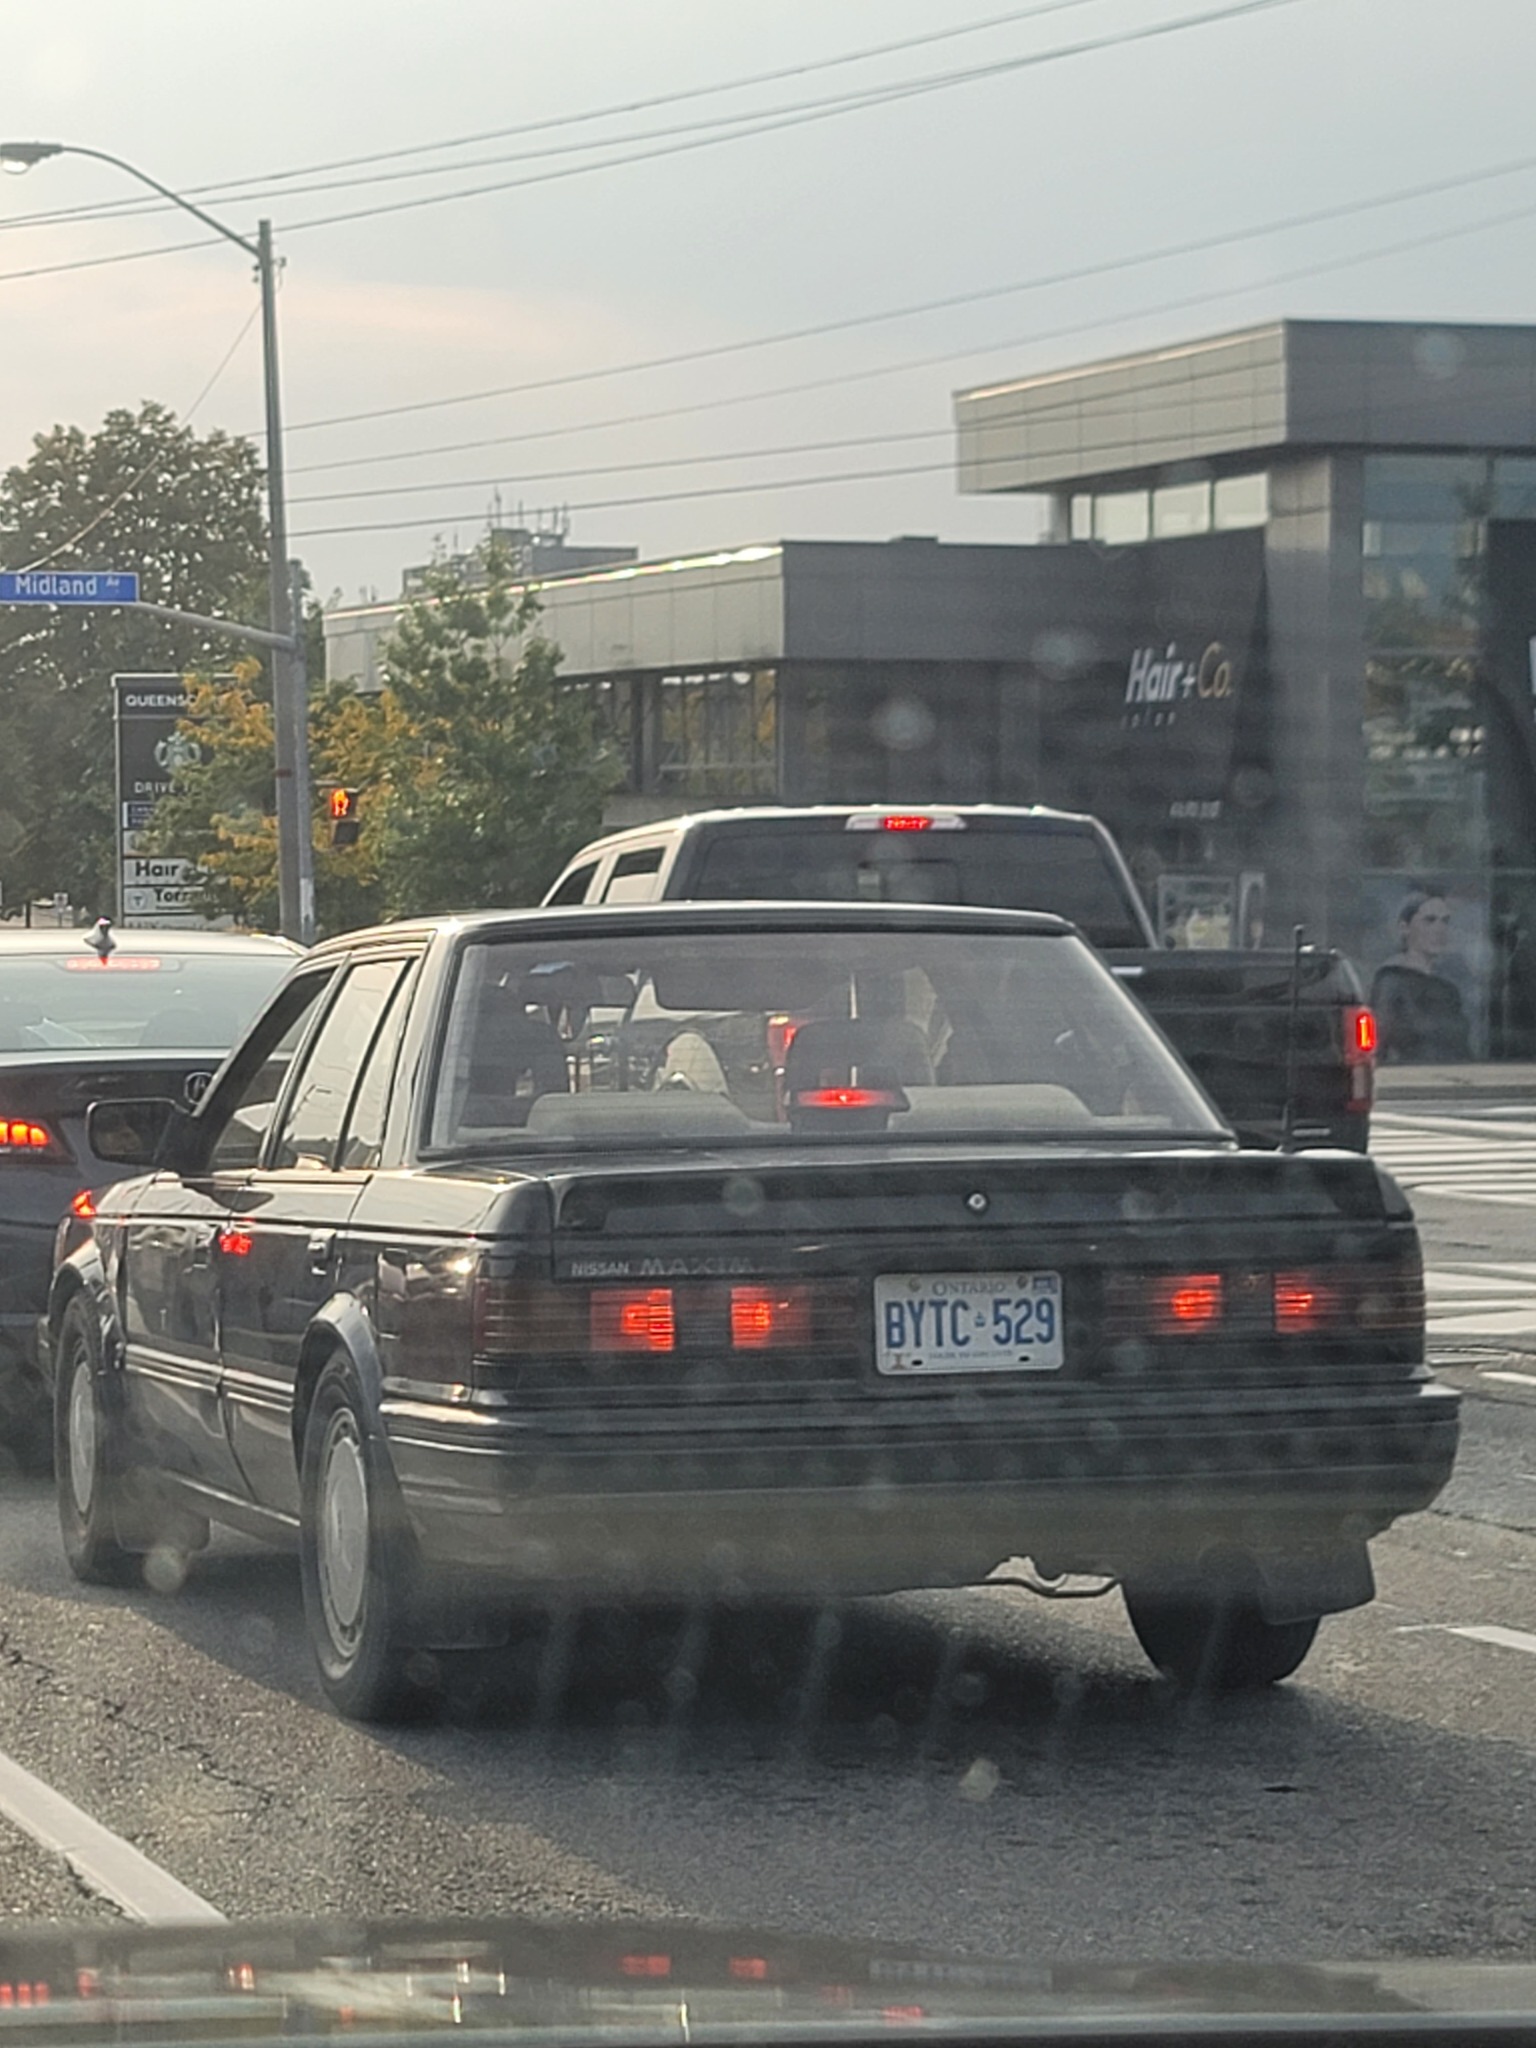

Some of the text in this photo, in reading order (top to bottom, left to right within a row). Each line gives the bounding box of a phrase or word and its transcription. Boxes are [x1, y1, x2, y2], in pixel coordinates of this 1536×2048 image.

[15, 575, 98, 596] Midland
[135, 861, 179, 877] Hair
[571, 1261, 630, 1276] NISSAN
[932, 1279, 1007, 1296] ONTARIO
[885, 1297, 1055, 1349] BYTC 529
